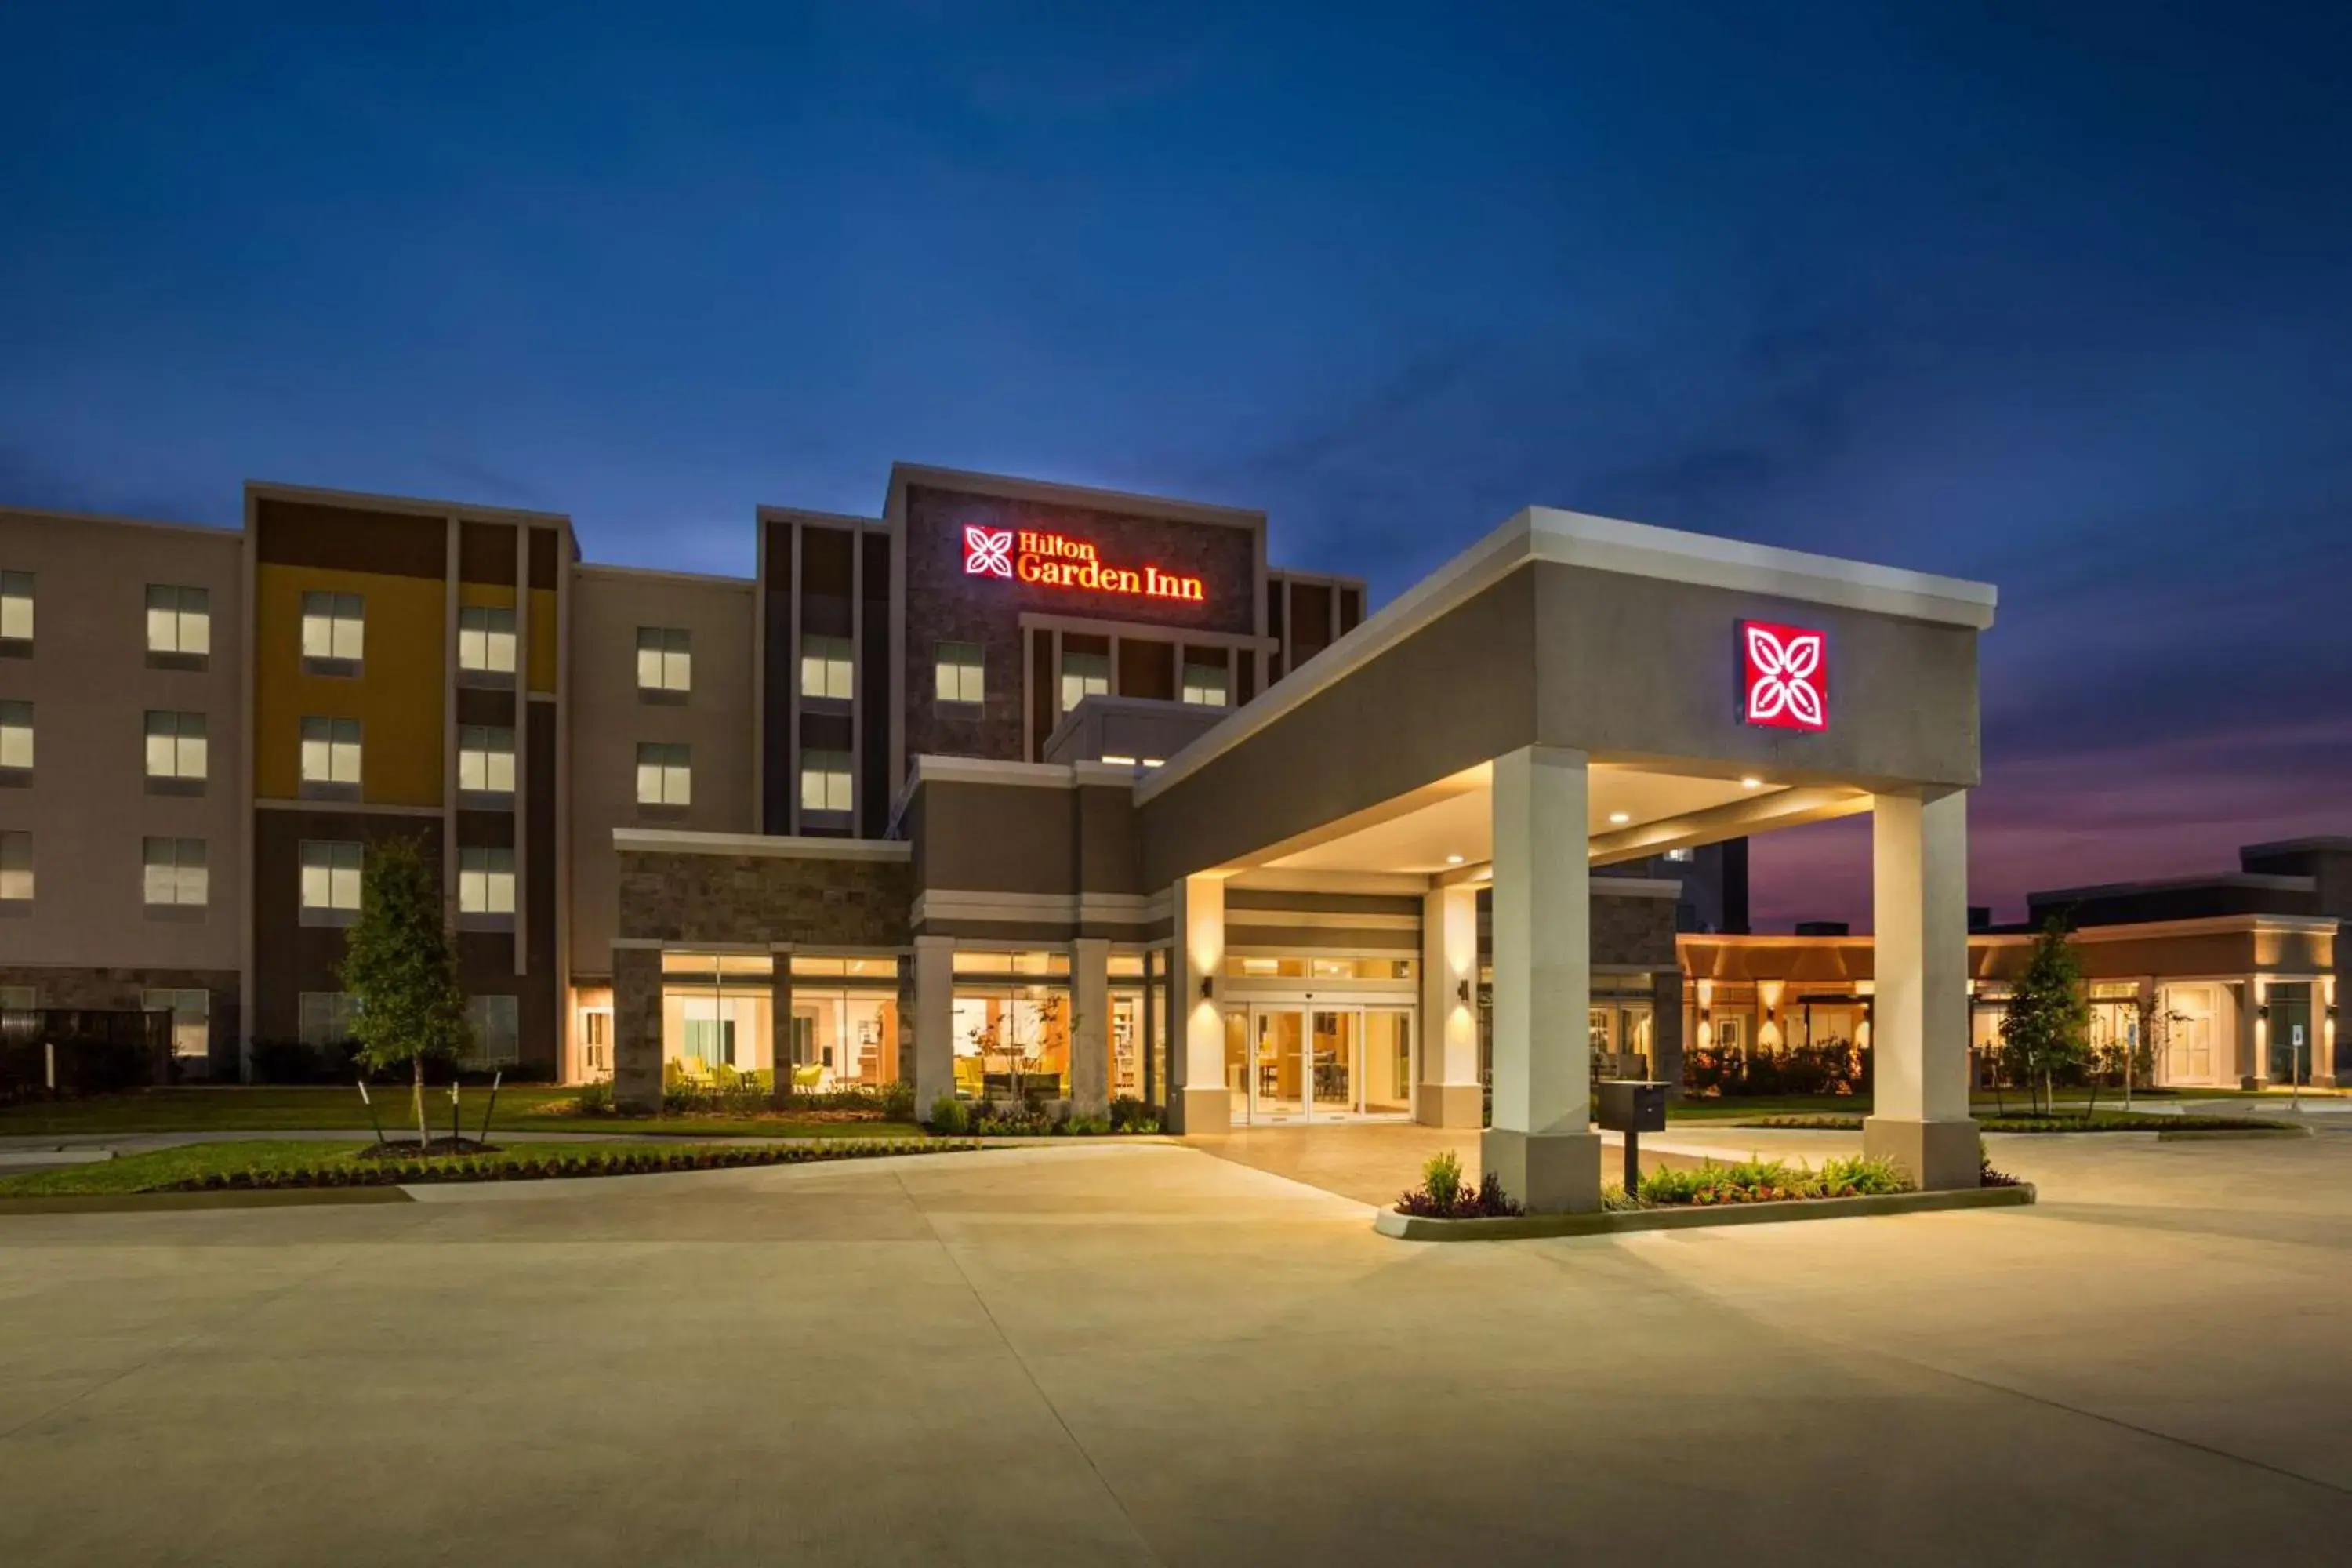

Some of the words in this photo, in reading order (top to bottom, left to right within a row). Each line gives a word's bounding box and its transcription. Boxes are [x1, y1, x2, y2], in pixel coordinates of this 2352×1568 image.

[1018, 532, 1095, 561] Hilton
[1018, 553, 1140, 593] Garden
[1145, 567, 1203, 600] Inn
